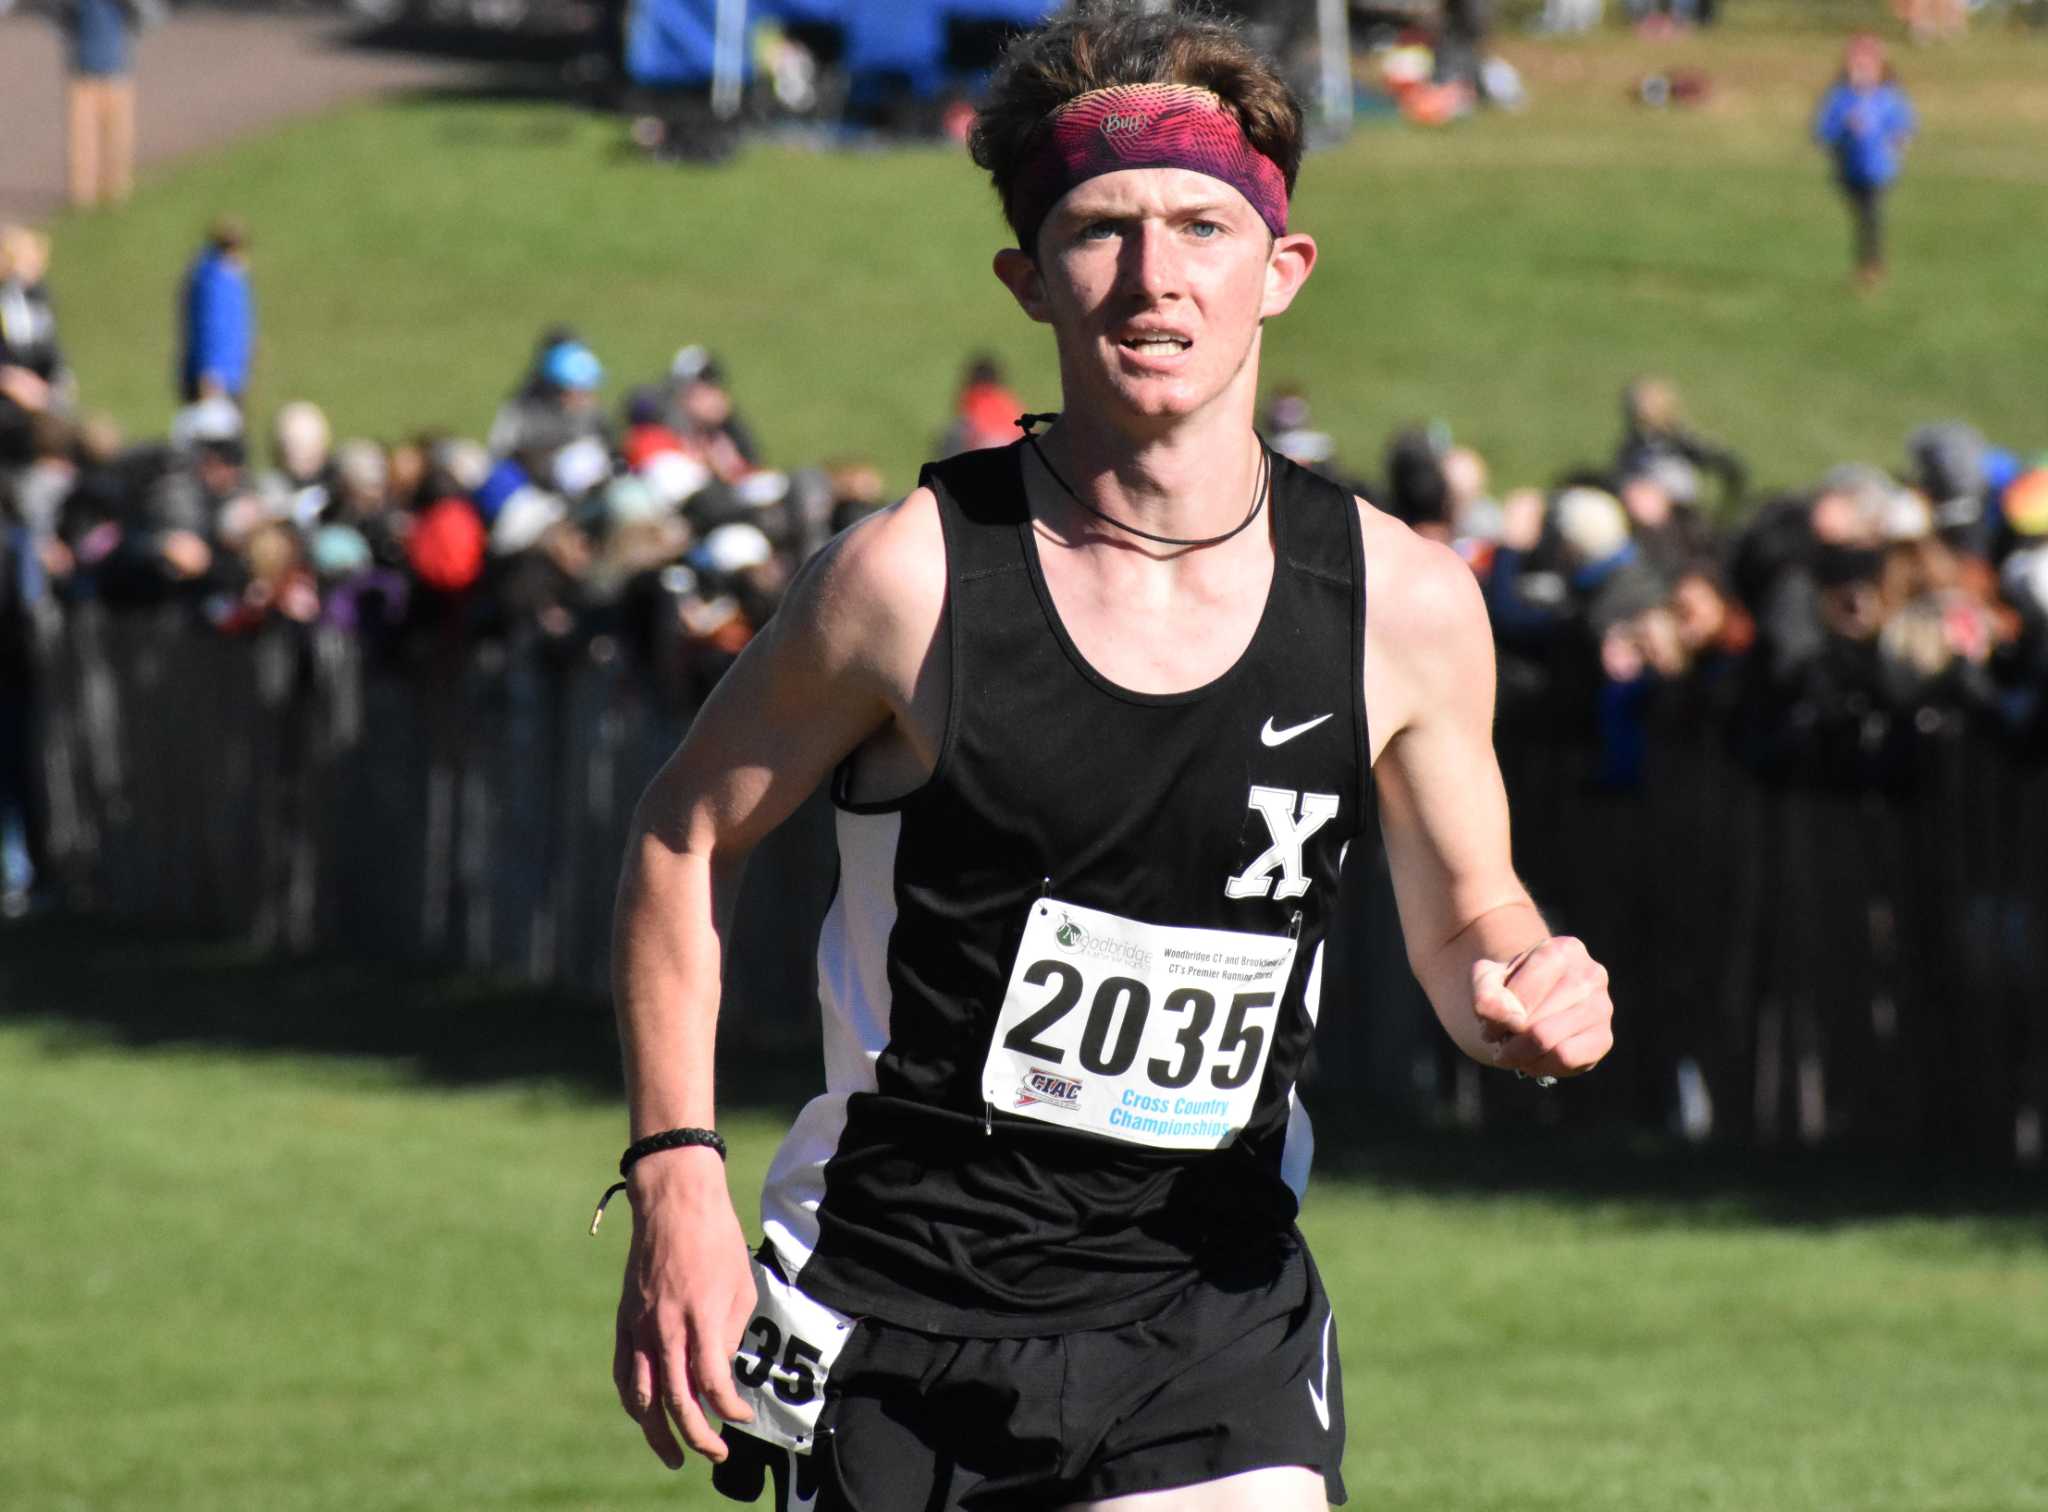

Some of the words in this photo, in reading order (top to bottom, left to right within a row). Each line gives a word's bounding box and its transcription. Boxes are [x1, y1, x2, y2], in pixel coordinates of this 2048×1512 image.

[1224, 785, 1340, 900] X
[1164, 947, 1211, 962] Woodbridge
[1212, 952, 1223, 963] CT
[1225, 955, 1239, 964] and
[1168, 964, 1186, 975] CT's
[1187, 966, 1220, 979] Premier
[1003, 959, 1276, 1090] 2035
[1031, 1074, 1082, 1100] CIAC
[1122, 1087, 1170, 1113] Cross
[1174, 1097, 1230, 1116] Country
[1109, 1107, 1231, 1136] Championships
[735, 1316, 823, 1406] 35
